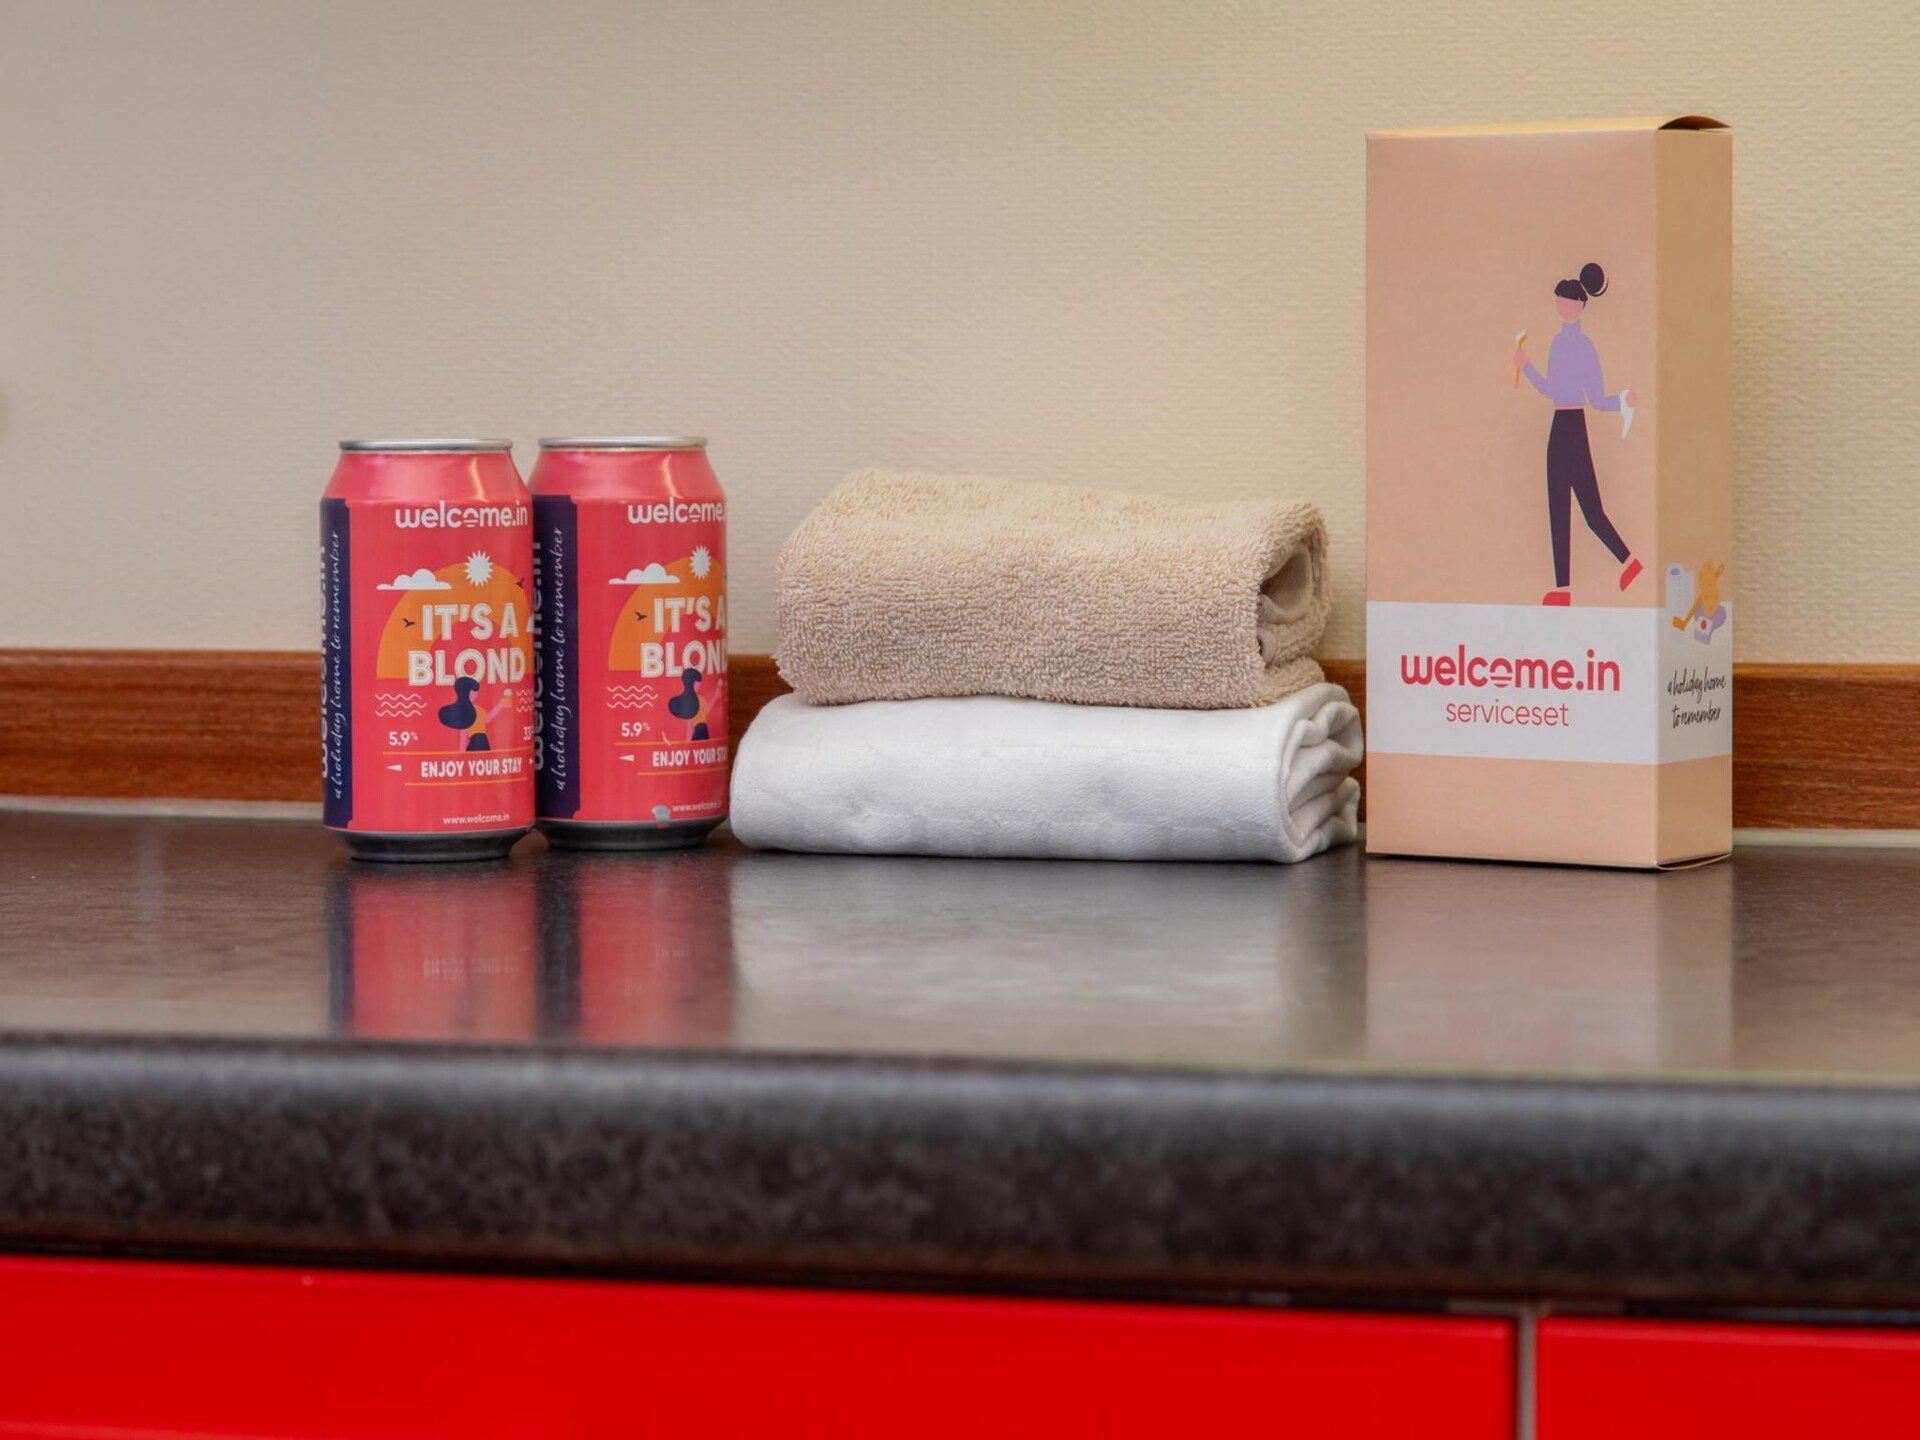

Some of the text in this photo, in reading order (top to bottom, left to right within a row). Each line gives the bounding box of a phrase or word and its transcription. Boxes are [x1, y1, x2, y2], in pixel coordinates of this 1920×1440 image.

[395, 499, 528, 529] welcome.in
[329, 532, 341, 629] remember
[549, 526, 565, 625] remember
[422, 602, 520, 641] IT'S A
[654, 596, 712, 633] IT'S
[330, 654, 342, 709] home
[408, 647, 526, 687] BLOND
[550, 647, 567, 702] home
[1401, 643, 1620, 692] welcome.in
[1673, 667, 1703, 704] holiday
[1704, 665, 1727, 692] home
[1446, 699, 1569, 727] serviceset
[1672, 699, 1721, 729] to remember
[330, 712, 347, 786] holiday
[550, 705, 573, 778] holiday
[652, 749, 690, 768] ENJOY
[691, 747, 717, 766] YOUR
[421, 756, 523, 778] ENJOY YOUR STAY
[443, 812, 511, 825] www.welcome.in
